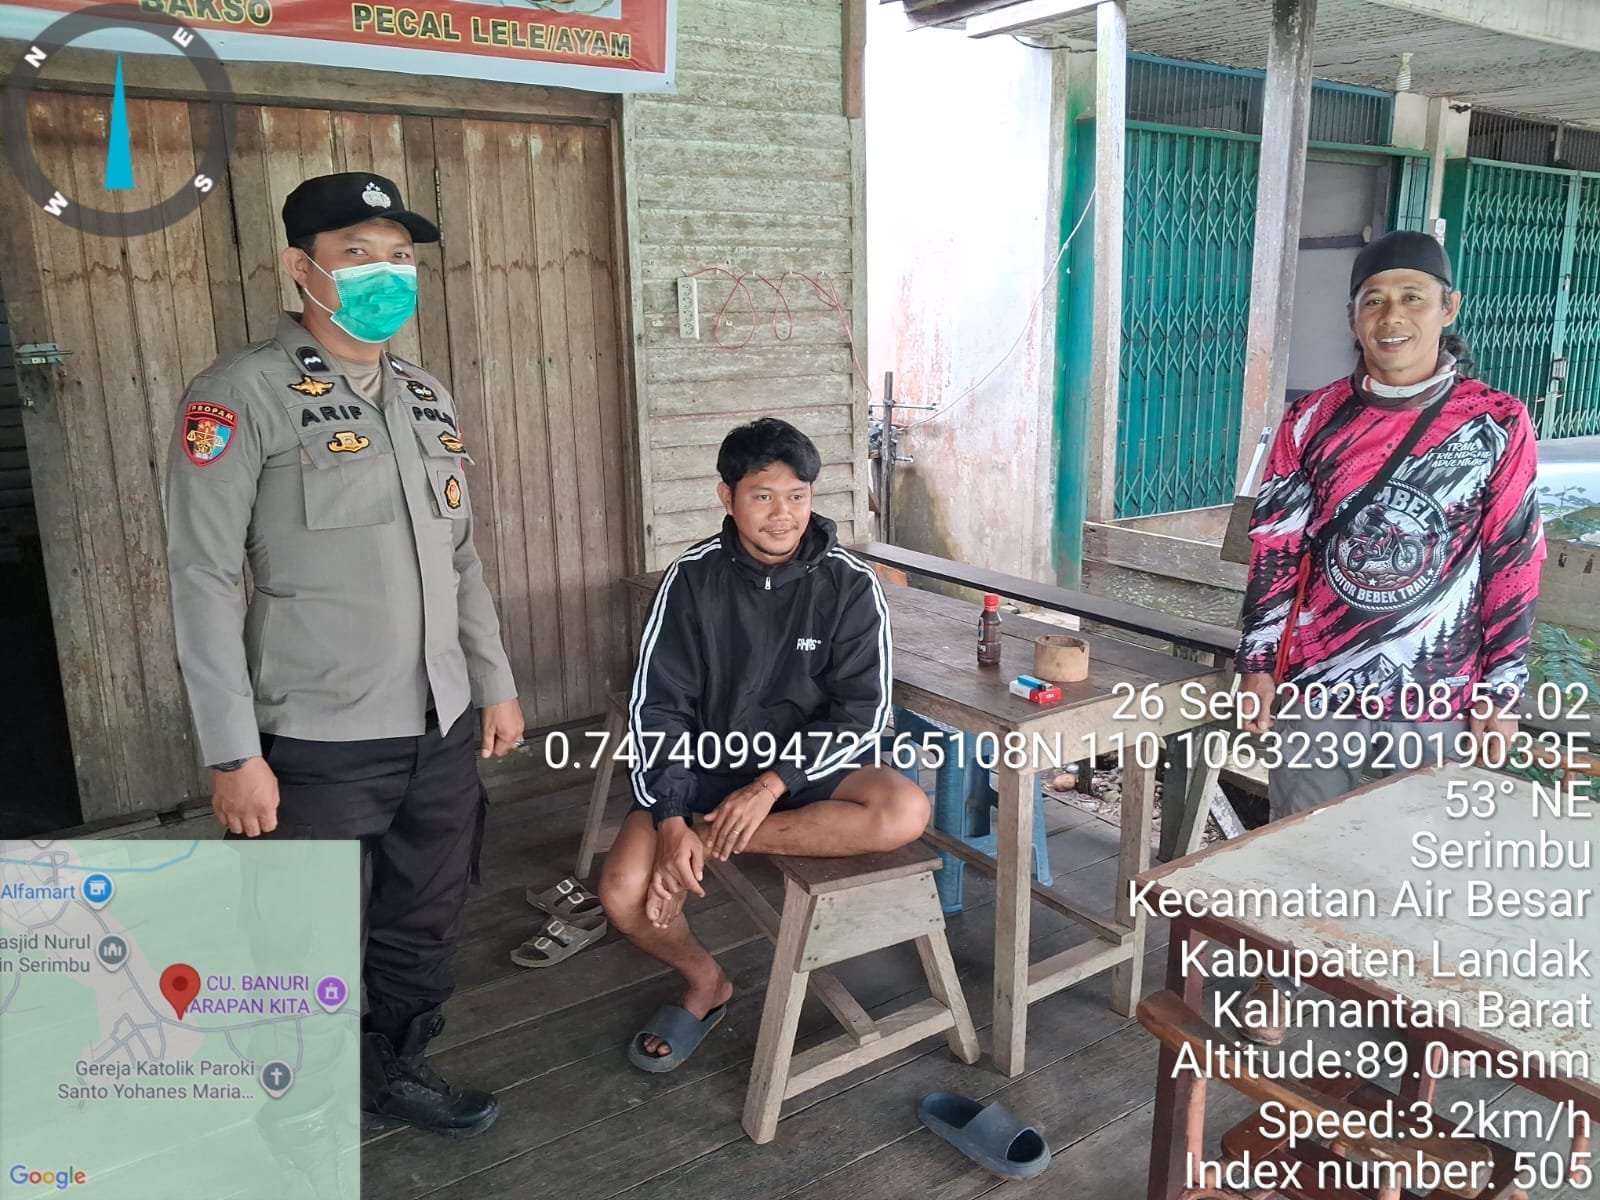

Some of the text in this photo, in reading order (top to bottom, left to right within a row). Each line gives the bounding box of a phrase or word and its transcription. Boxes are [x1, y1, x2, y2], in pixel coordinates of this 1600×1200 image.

[352, 2, 632, 58] PECAL LELE/AYAM
[191, 404, 234, 421] PROPAM
[301, 405, 363, 427] ARIF
[1331, 565, 1431, 604] MOTOR BEBEK TRAIL
